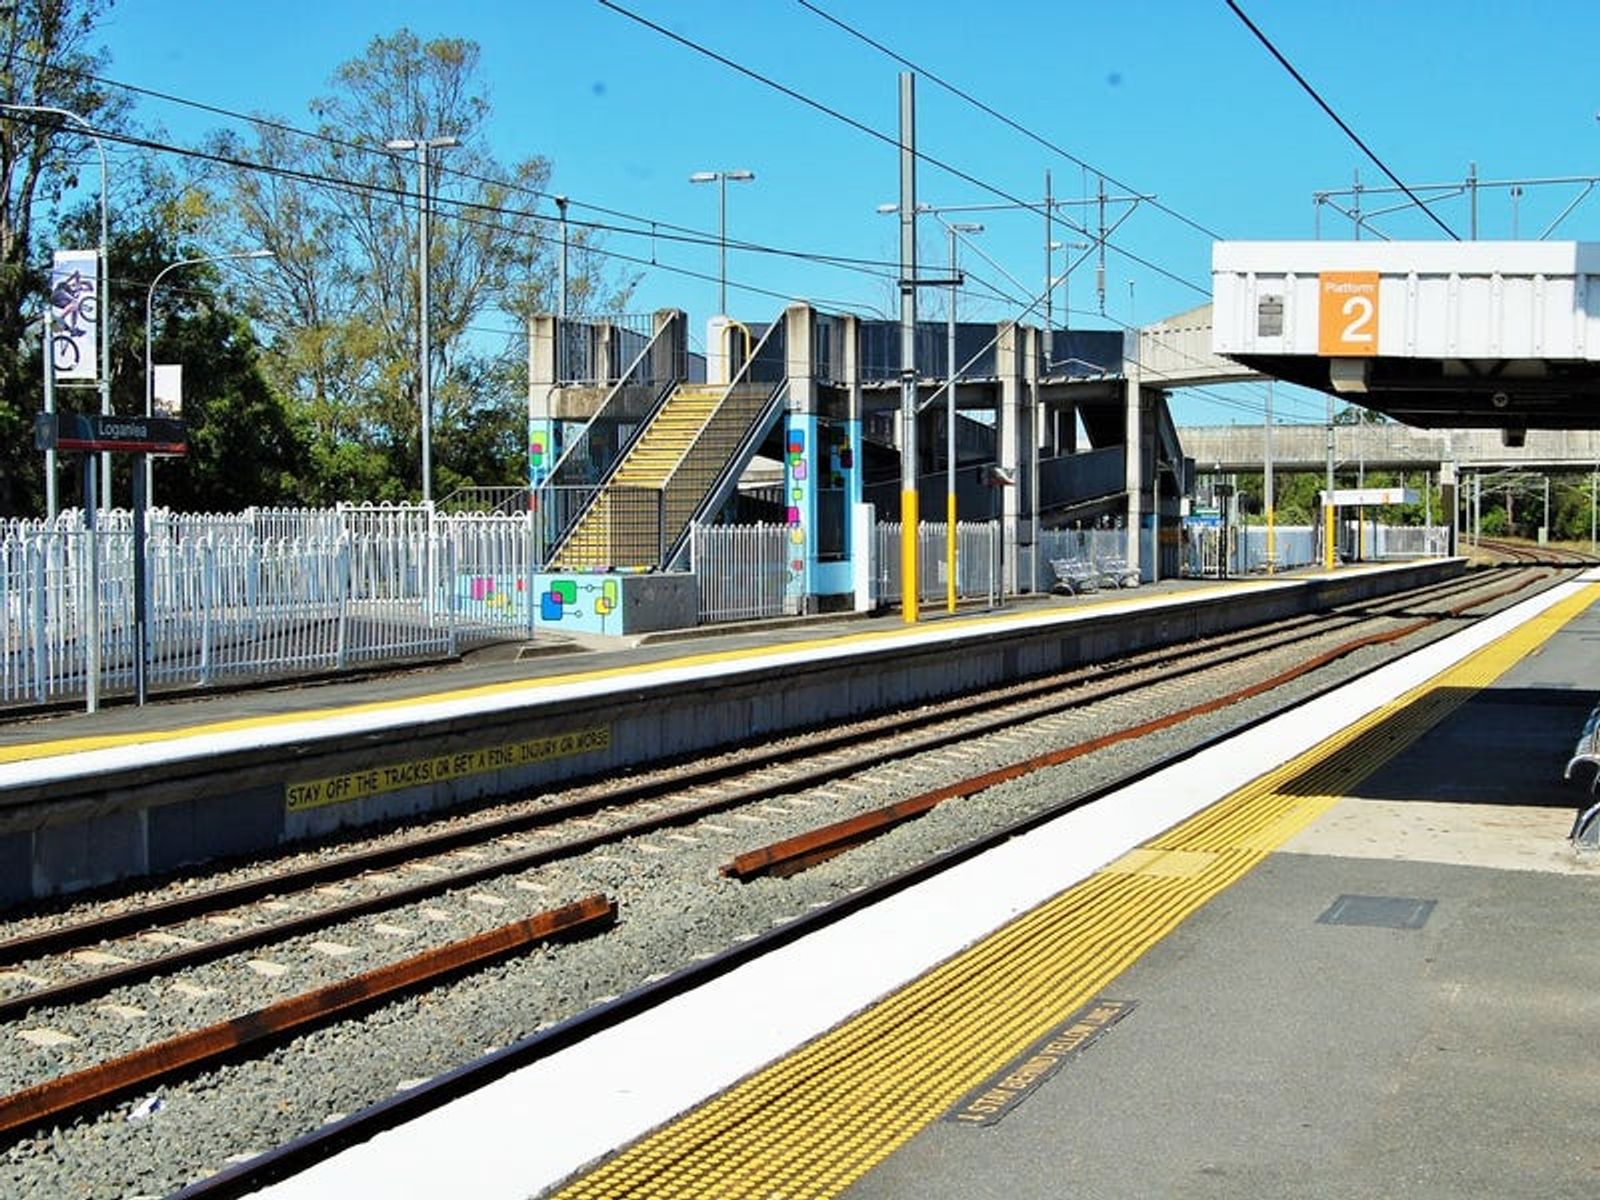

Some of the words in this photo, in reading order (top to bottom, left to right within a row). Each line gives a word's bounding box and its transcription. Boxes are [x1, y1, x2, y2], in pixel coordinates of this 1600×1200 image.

[1341, 296, 1373, 342] 2
[288, 784, 321, 807] STAY
[326, 776, 351, 799] OFF
[356, 770, 379, 793] THE
[436, 758, 450, 777] OR
[453, 752, 474, 774] GET
[478, 751, 486, 769] A
[561, 736, 574, 752] OR
